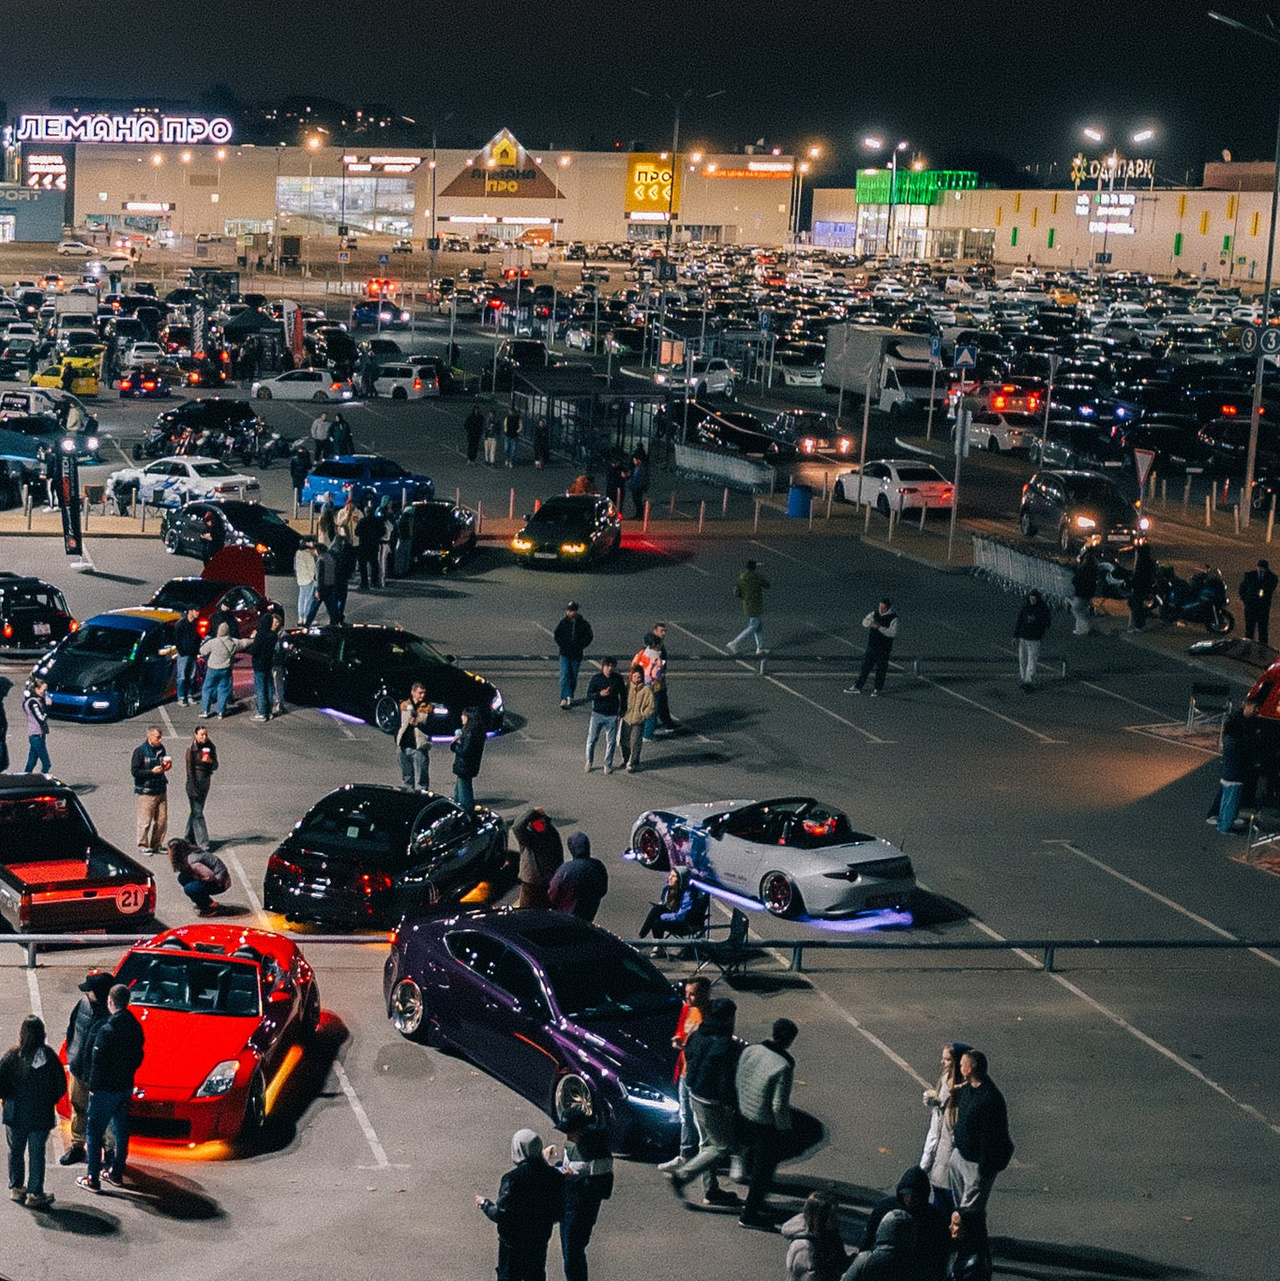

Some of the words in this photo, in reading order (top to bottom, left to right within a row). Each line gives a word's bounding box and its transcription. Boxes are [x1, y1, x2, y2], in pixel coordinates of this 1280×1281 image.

[19, 114, 160, 142] ЛЕМАНА
[162, 116, 234, 144] ПРО
[636, 170, 673, 183] ПРО
[485, 179, 519, 193] ПРО
[121, 888, 140, 909] 21
